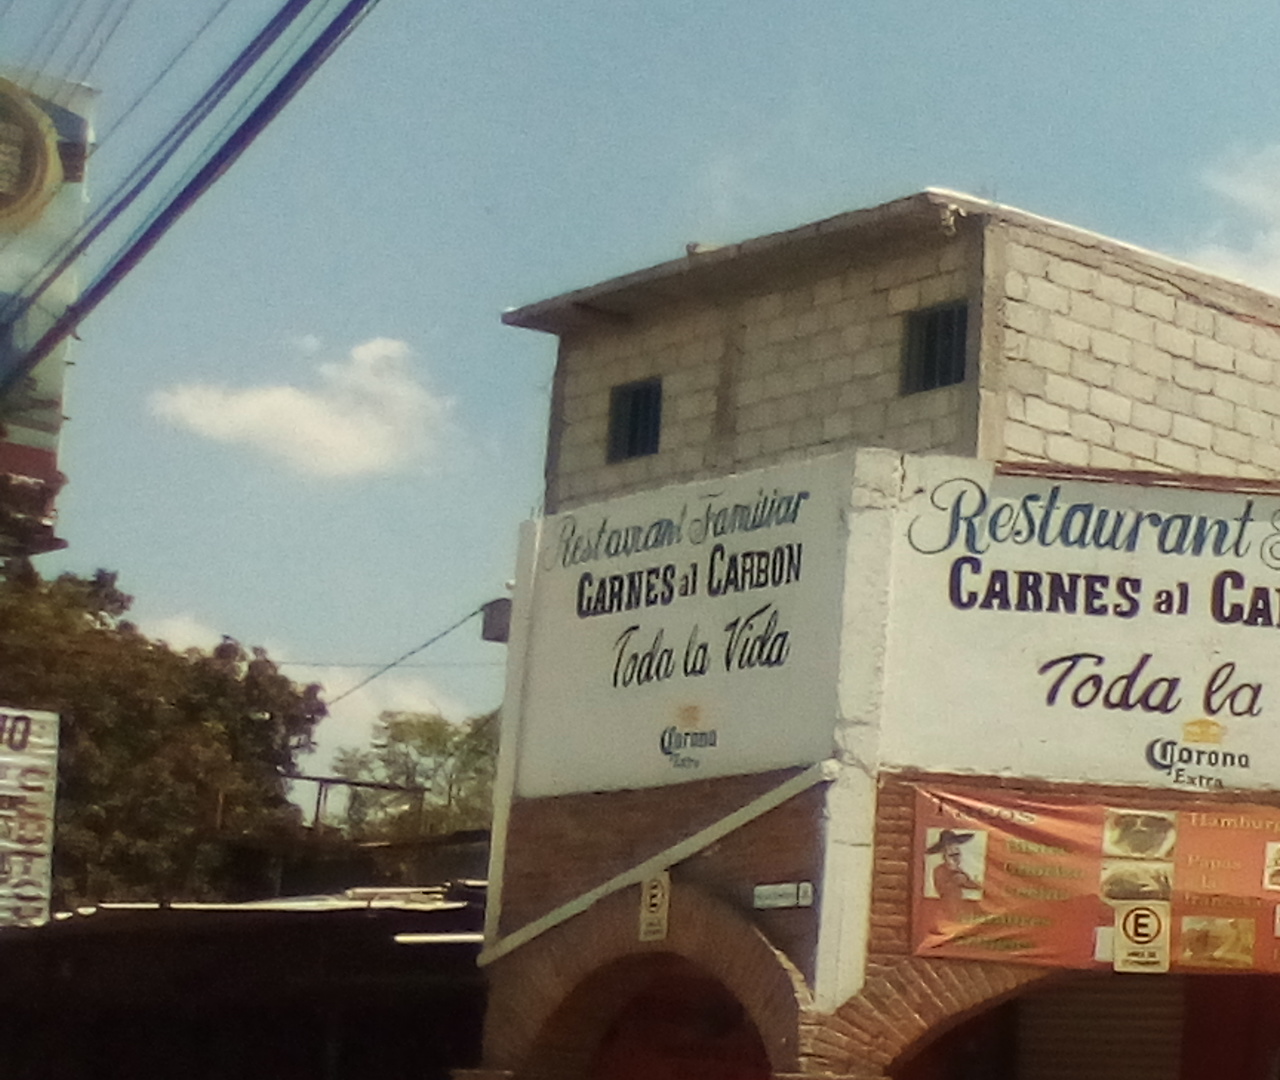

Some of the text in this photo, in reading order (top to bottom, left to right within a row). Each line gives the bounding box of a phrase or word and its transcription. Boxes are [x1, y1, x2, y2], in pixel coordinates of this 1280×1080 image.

[543, 488, 810, 572] Restaurant Familiar
[909, 477, 1256, 558] Restaurant
[576, 541, 804, 619] CARNES al CARBON
[948, 556, 1142, 618] CARNES
[1154, 582, 1189, 616] al
[611, 602, 792, 688] Toda la Vida
[1038, 652, 1182, 716] Toda
[1203, 662, 1264, 718] la
[660, 725, 717, 756] Corona
[1145, 738, 1250, 775] Corona
[1173, 767, 1225, 789] Extra
[1133, 913, 1151, 938] E
